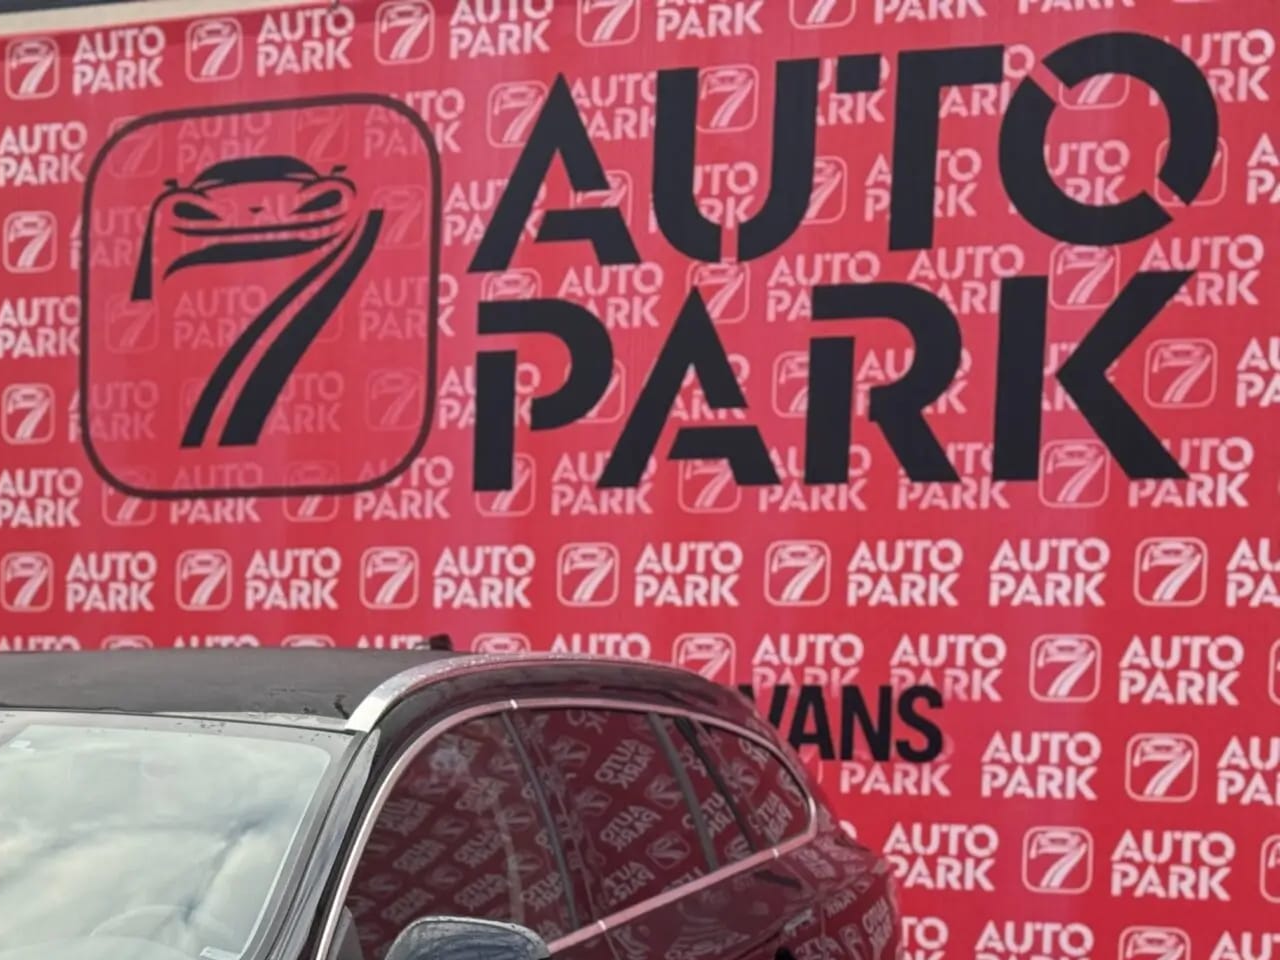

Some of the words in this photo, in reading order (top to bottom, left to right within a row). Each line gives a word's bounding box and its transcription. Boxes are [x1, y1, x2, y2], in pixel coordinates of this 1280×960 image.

[257, 7, 354, 44] AUTO
[657, 1, 763, 42] PARK
[73, 26, 165, 64] AUTO
[449, 19, 550, 59] PARK
[258, 37, 352, 76] PARK
[73, 56, 162, 95] PARK
[466, 31, 1219, 273] AUTO
[767, 251, 880, 288] AUTO
[907, 244, 1025, 281] AUTO
[1139, 234, 1265, 271] AUTO
[558, 262, 663, 297] AUTO
[473, 270, 1197, 492] PARK
[353, 488, 450, 522] PARK
[551, 485, 653, 517] PARK
[759, 478, 868, 513] PARK
[1128, 473, 1249, 507] PARK
[67, 552, 156, 581] AUTO
[245, 547, 341, 579] AUTO
[434, 545, 535, 577] AUTO
[636, 542, 742, 574] AUTO
[848, 540, 963, 573] AUTO
[990, 538, 1108, 571] AUTO
[66, 581, 153, 611] PARK
[246, 578, 337, 610] PARK
[434, 577, 531, 608] PARK
[635, 574, 738, 606] PARK
[848, 573, 958, 606] PARK
[990, 573, 1105, 606] PARK
[752, 633, 864, 667] AUTO
[890, 633, 1007, 668] AUTO
[1120, 636, 1243, 670] AUTO
[1119, 670, 1238, 705] PARK
[982, 732, 1101, 765] AUTO
[840, 763, 951, 797] PARK
[982, 765, 1096, 800] PARK
[883, 822, 999, 858] AUTO
[1112, 830, 1235, 866] AUTO
[1112, 863, 1230, 900] PARK
[975, 922, 1093, 956] AUTO
